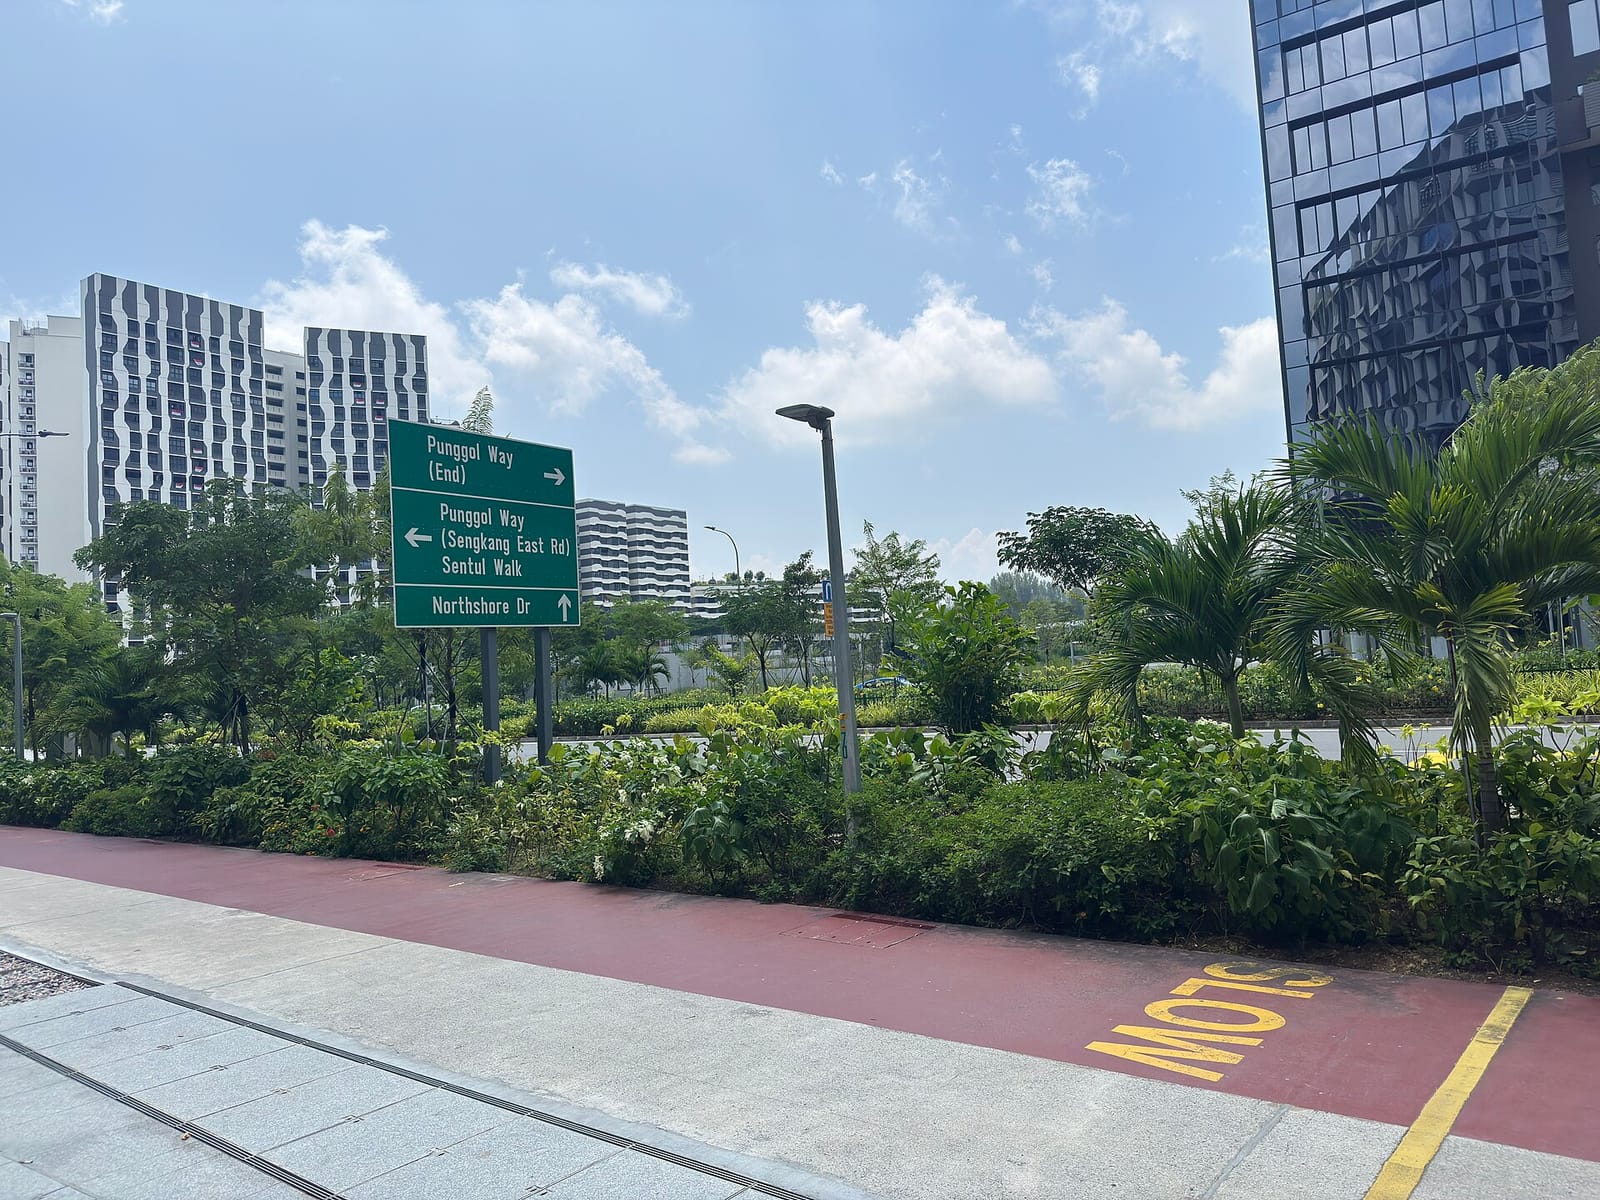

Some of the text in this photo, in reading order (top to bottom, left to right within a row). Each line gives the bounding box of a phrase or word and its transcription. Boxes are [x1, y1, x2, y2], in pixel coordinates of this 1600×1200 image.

[427, 435, 513, 469] Punggol Way
[429, 460, 466, 485] (End)
[440, 503, 525, 532] Punggol Way
[441, 528, 570, 556] (Sengkang East Rd)
[442, 556, 522, 577] Sentul Walk
[432, 596, 530, 615] Northshore Dr
[1084, 961, 1335, 1083] SLOW
